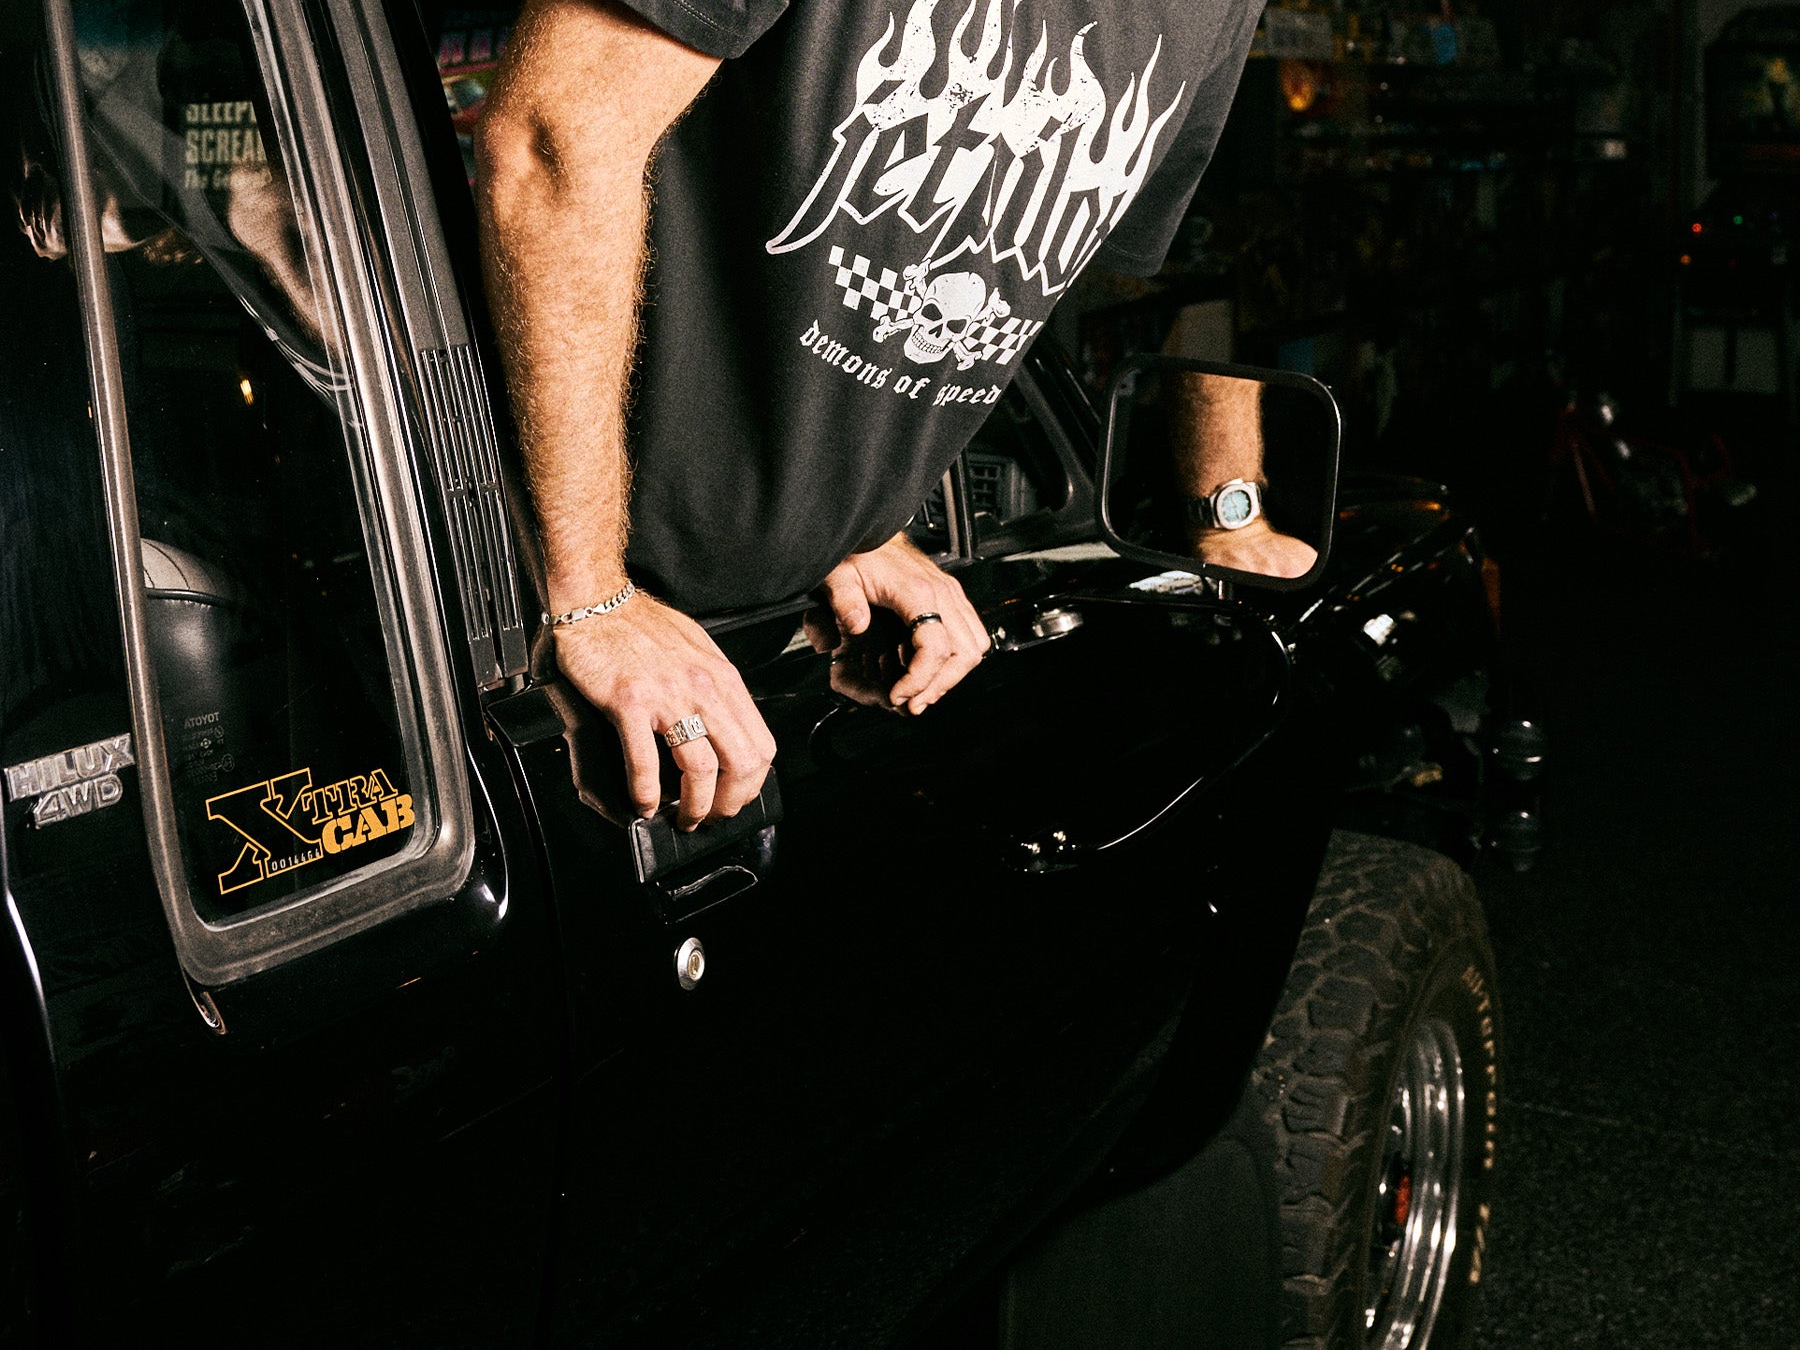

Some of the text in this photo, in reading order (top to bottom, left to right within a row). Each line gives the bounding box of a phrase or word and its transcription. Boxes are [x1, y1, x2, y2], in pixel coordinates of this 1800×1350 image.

[800, 319, 1002, 406] demons of speed
[3, 732, 136, 803] HILUX
[33, 773, 124, 830] 4WD
[206, 767, 399, 895] XTRA
[322, 793, 416, 855] CAB
